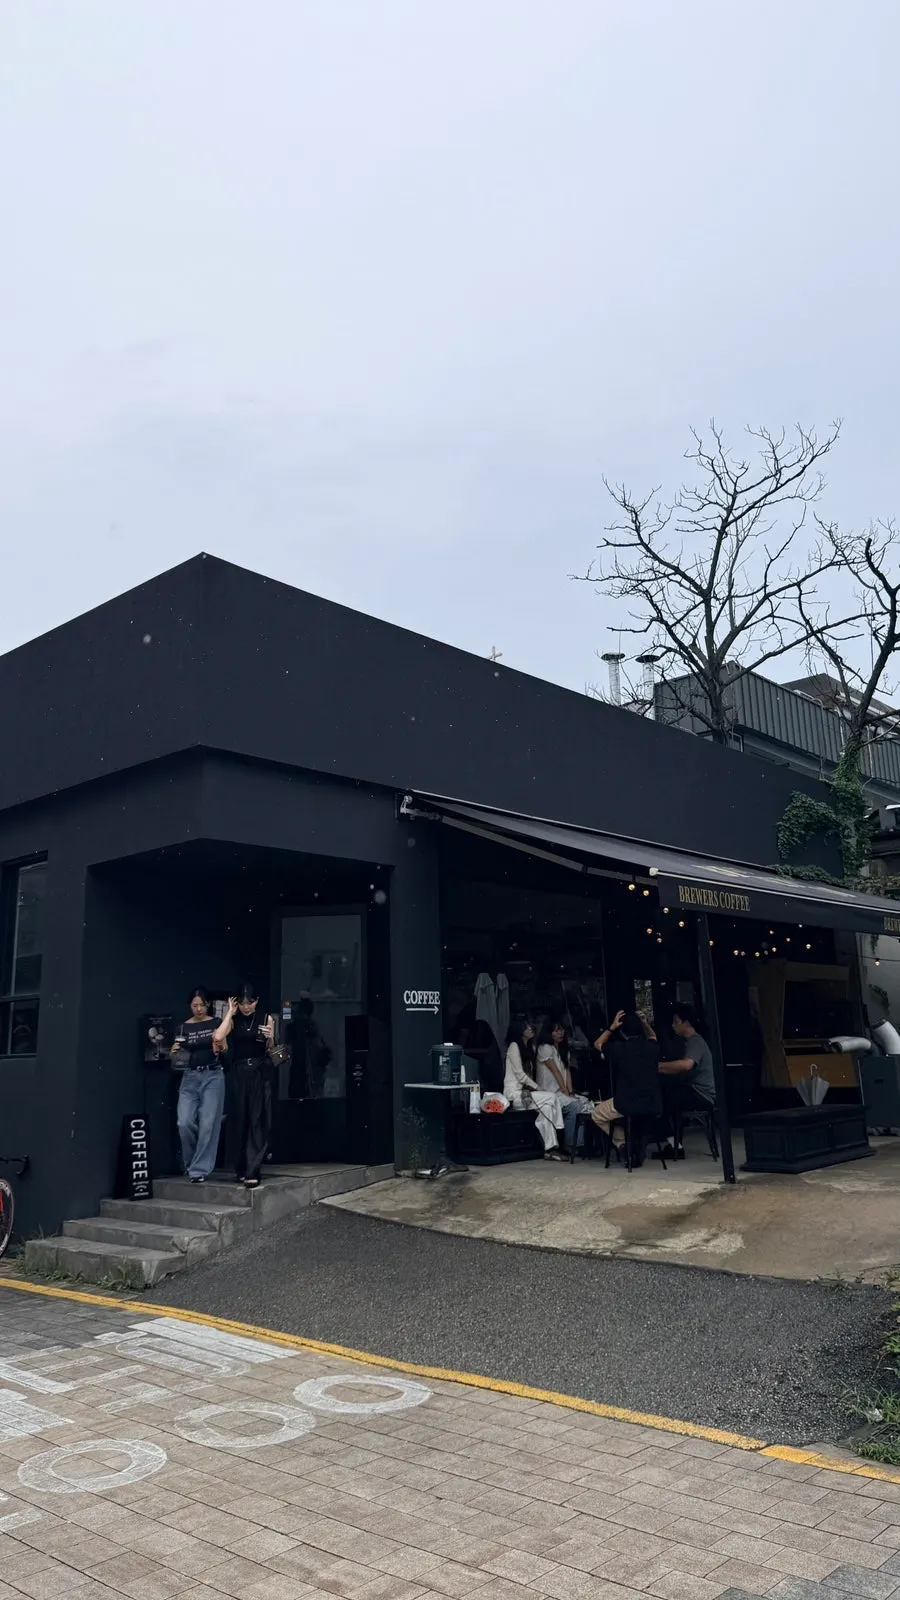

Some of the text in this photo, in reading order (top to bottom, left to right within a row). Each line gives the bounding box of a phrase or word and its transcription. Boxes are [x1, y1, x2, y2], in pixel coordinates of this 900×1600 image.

[678, 885, 750, 911] BREWERS COFFEE
[403, 990, 440, 1004] COFFEE
[130, 1119, 148, 1179] COFFEE
